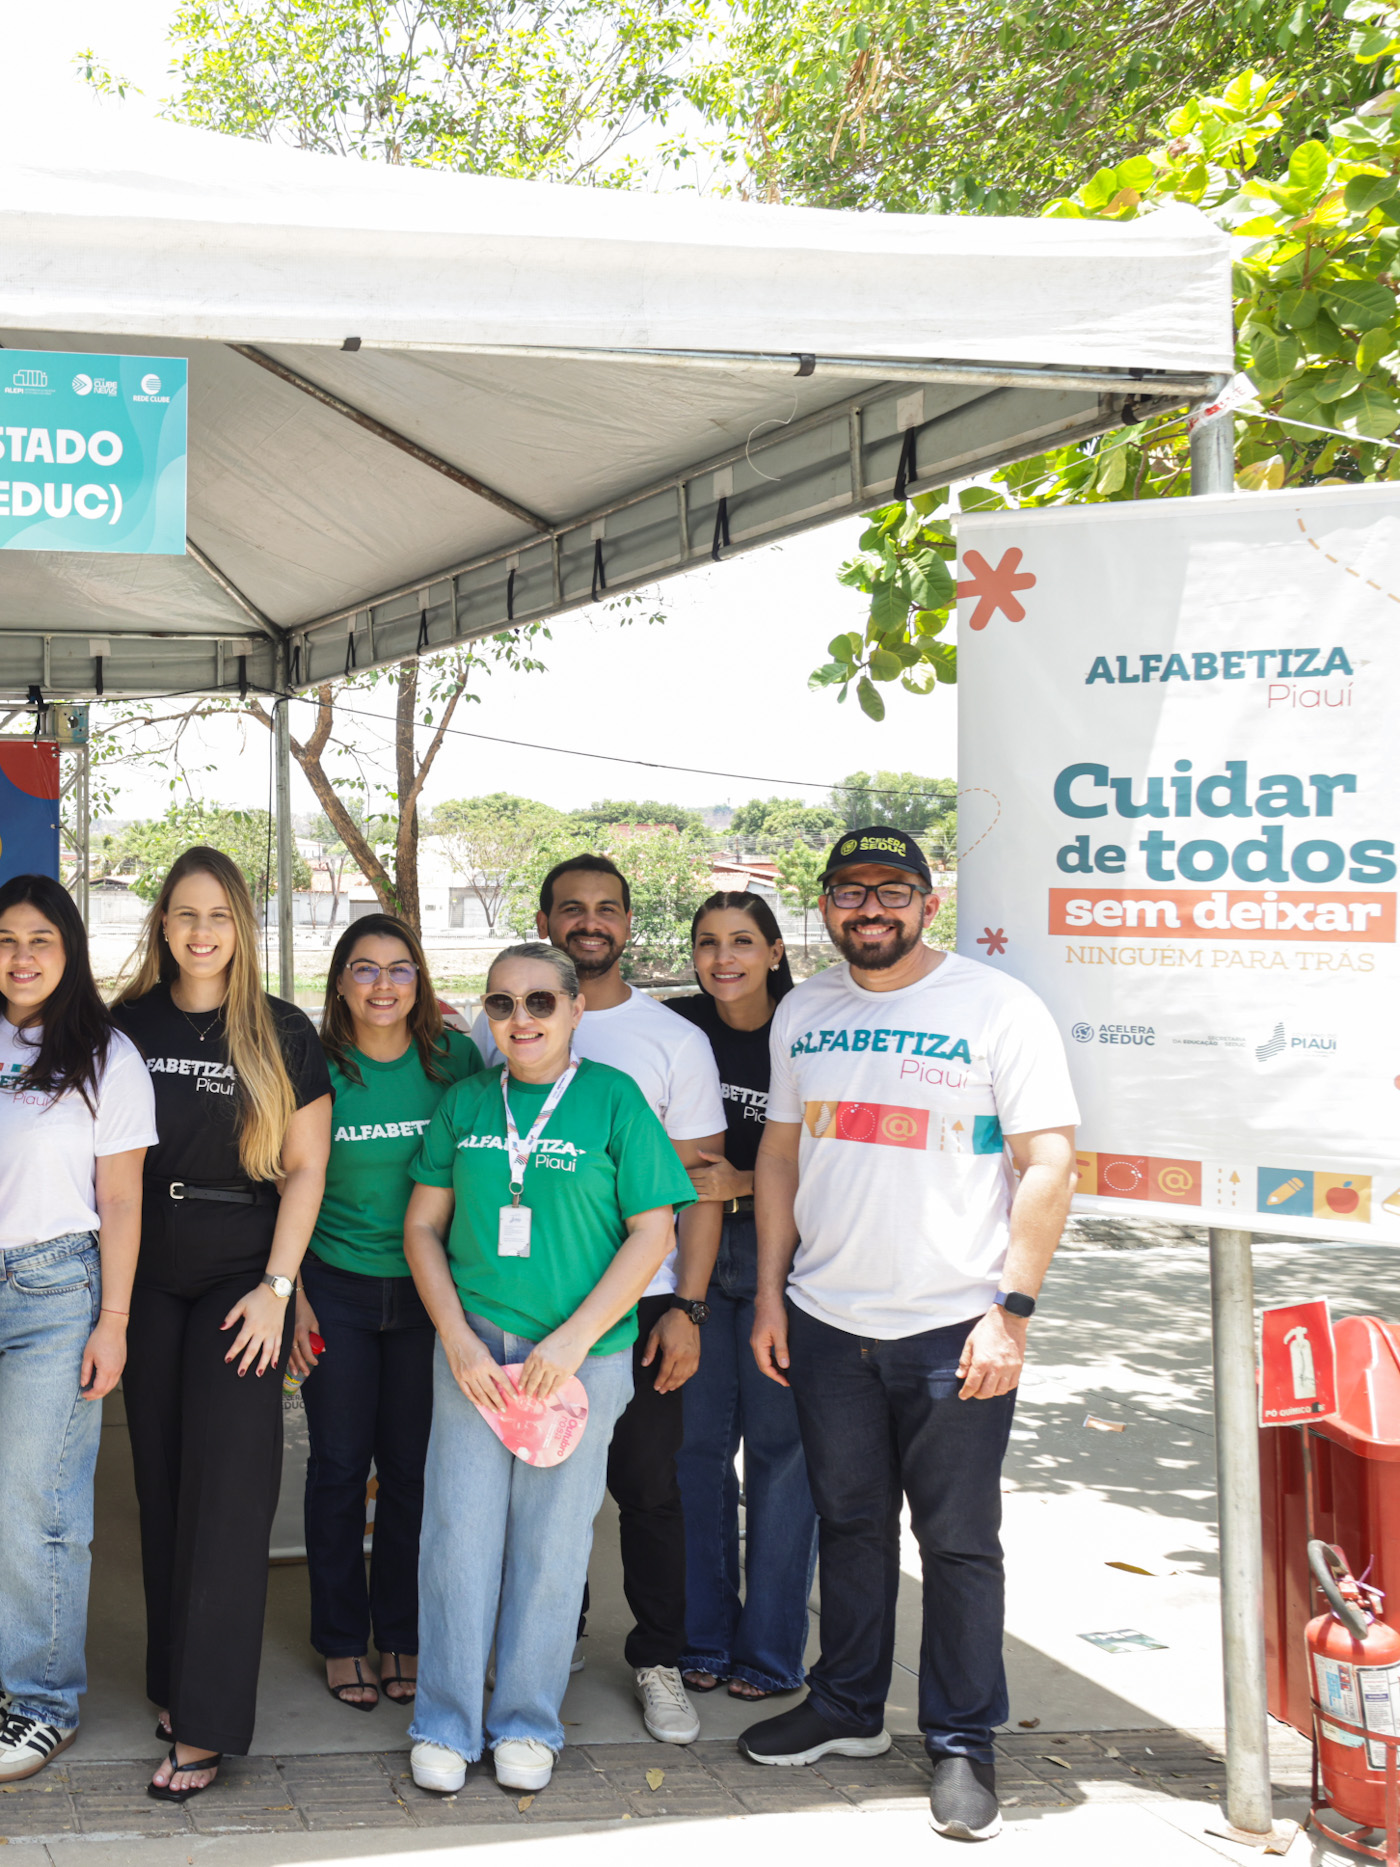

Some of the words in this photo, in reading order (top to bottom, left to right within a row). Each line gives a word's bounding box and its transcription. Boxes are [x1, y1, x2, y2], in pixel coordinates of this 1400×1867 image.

[4, 386, 24, 395] ALEPI
[133, 395, 149, 403] REDE
[150, 396, 171, 404] CLUBE
[1085, 646, 1354, 685] ALFABETIZA
[1267, 681, 1354, 708] Piauí
[1053, 759, 1357, 819] Cuidar
[859, 842, 907, 857] SEDUC
[860, 836, 907, 852] ACELERA
[1056, 835, 1126, 874] de
[1139, 825, 1398, 884] todos
[1065, 898, 1182, 928] sem
[1192, 891, 1383, 932] deixar
[1064, 944, 1204, 968] NINGUÉM
[1211, 949, 1290, 970] PARA
[1295, 947, 1376, 972] TRÁS
[1098, 1024, 1156, 1035] ACELERA
[1098, 1033, 1156, 1046] SEDUC
[790, 1029, 972, 1065] ALFABETIZA
[1183, 1039, 1219, 1047] EDUCAÇÃO
[146, 1058, 236, 1081] FABETIZA
[899, 1059, 972, 1090] Piauí
[195, 1077, 236, 1096] Piauí
[334, 1119, 431, 1141] ALFABET
[534, 1154, 577, 1173] Piauí
[1264, 1408, 1278, 1418] PÓ
[557, 1419, 578, 1457] Outubro
